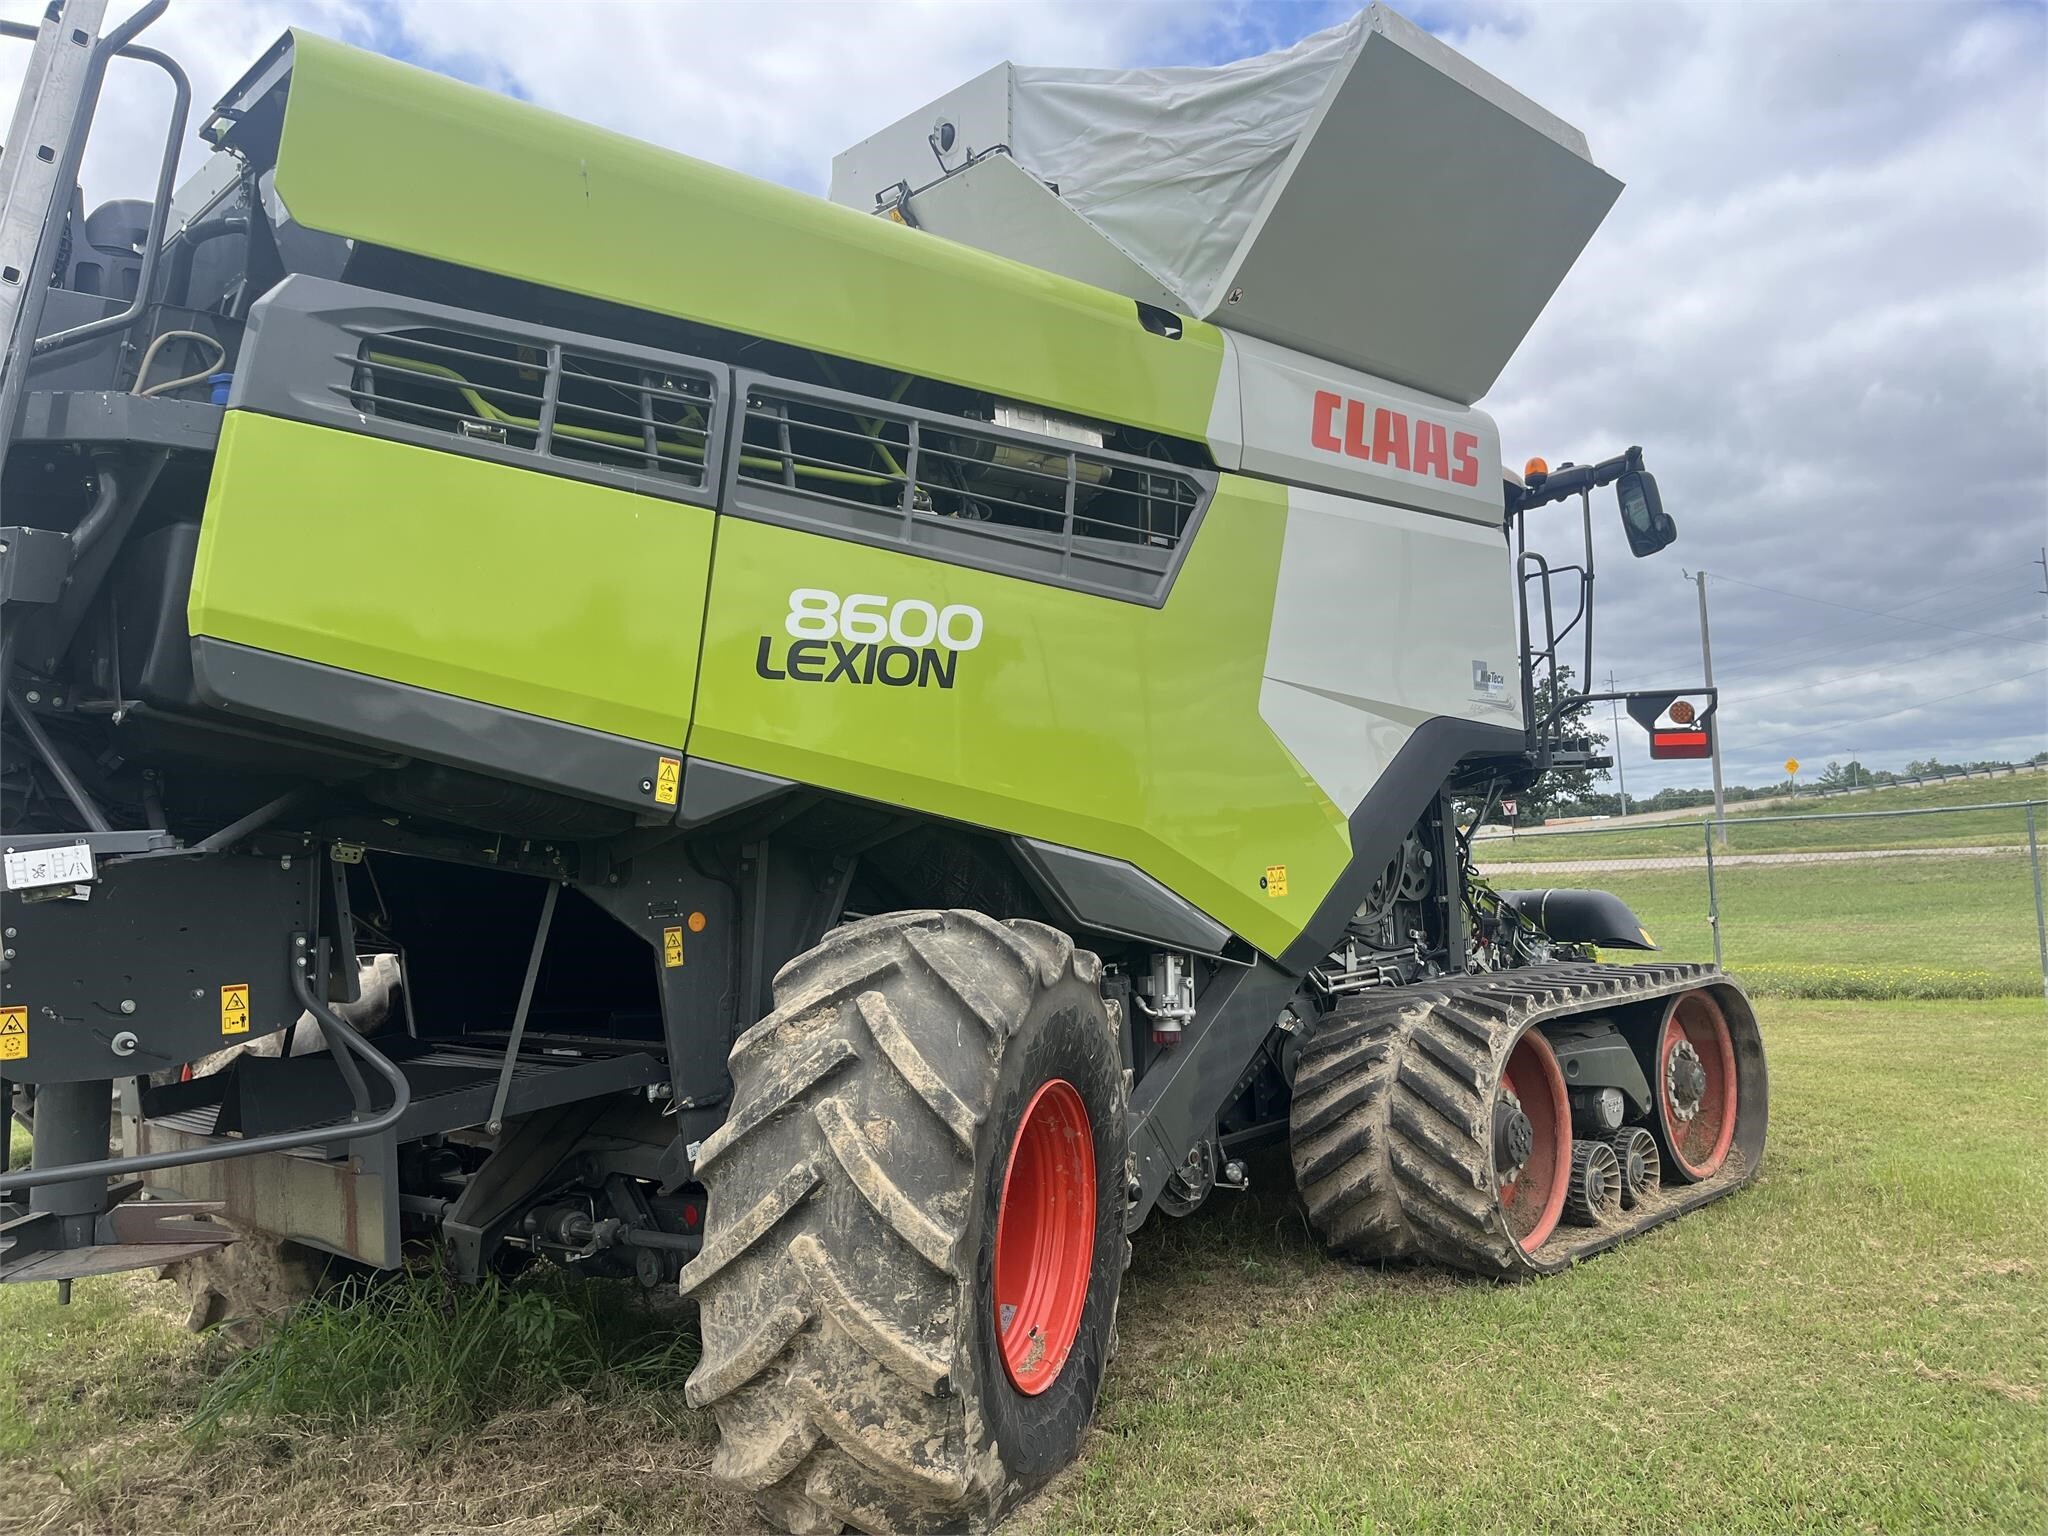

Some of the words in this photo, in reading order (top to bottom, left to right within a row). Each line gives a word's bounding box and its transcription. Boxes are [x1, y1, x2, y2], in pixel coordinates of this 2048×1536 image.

[1311, 389, 1479, 487] CLAAS
[784, 588, 984, 651] 8600
[755, 636, 959, 689] LEXION
